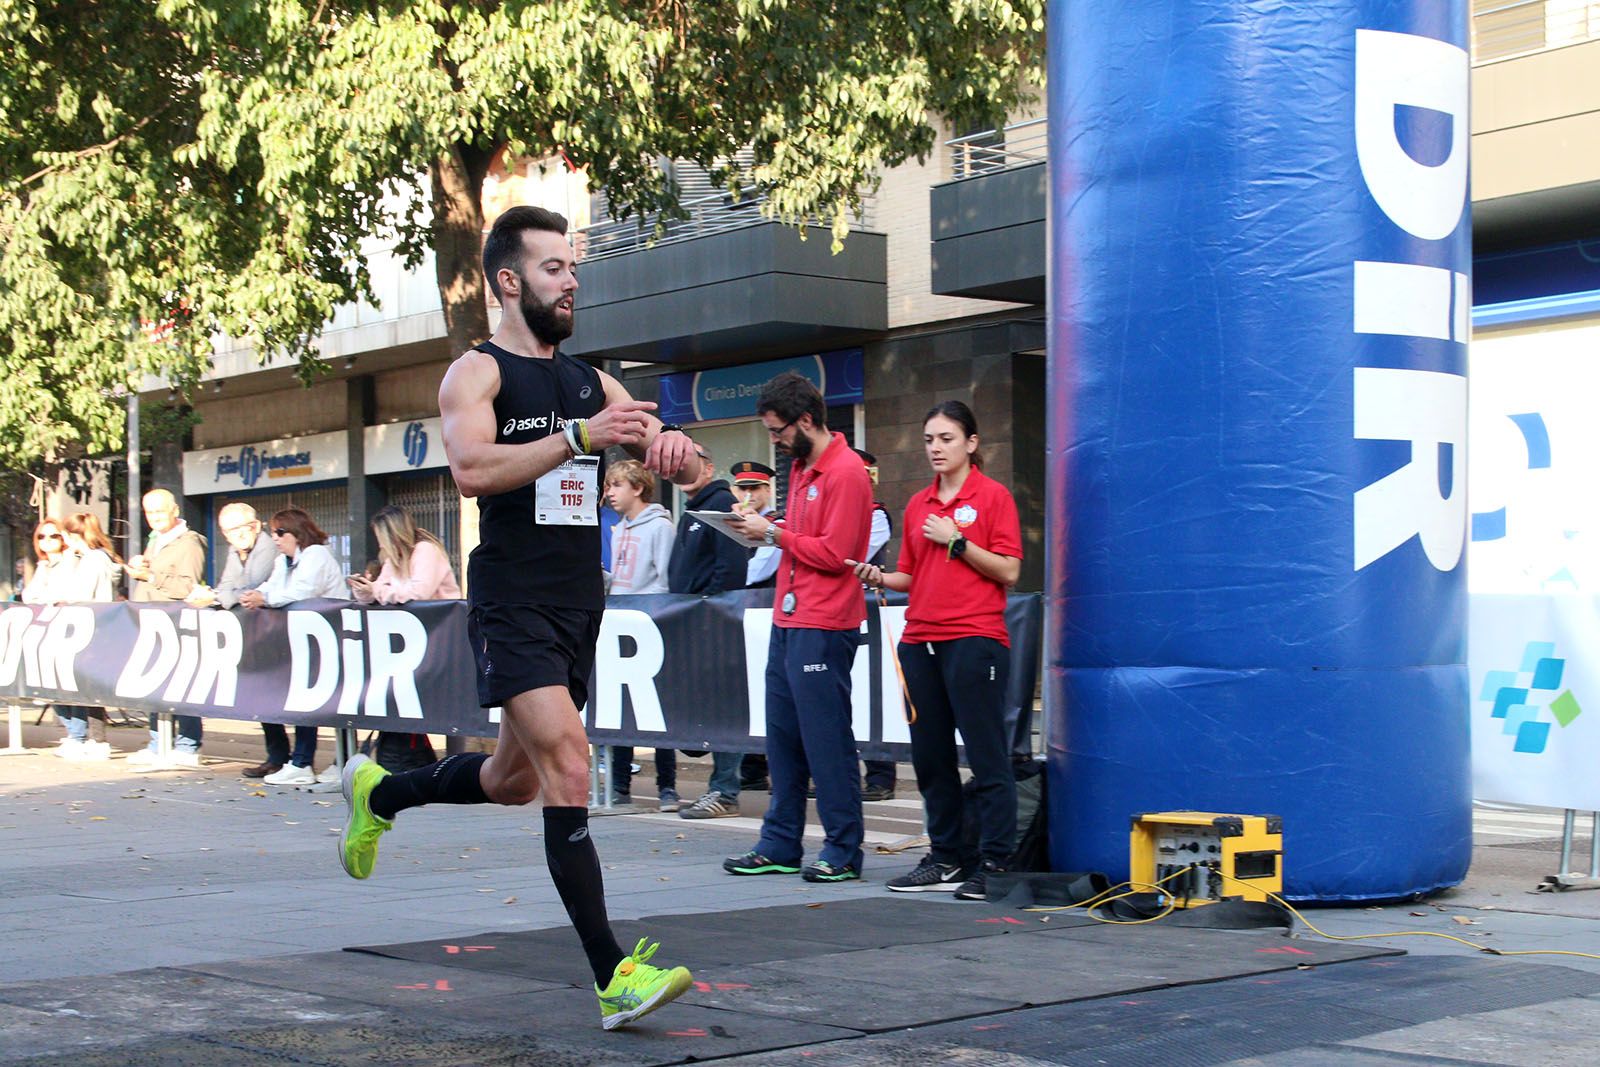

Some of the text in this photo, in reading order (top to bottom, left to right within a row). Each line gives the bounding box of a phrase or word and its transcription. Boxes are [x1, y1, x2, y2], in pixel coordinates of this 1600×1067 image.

[1353, 28, 1468, 572] DiR
[560, 480, 585, 491] ERIC
[560, 494, 584, 507] 1115
[0, 606, 96, 692] DiR
[115, 608, 244, 707] DiR
[283, 608, 428, 720] DiR
[803, 663, 829, 673] RFEA
